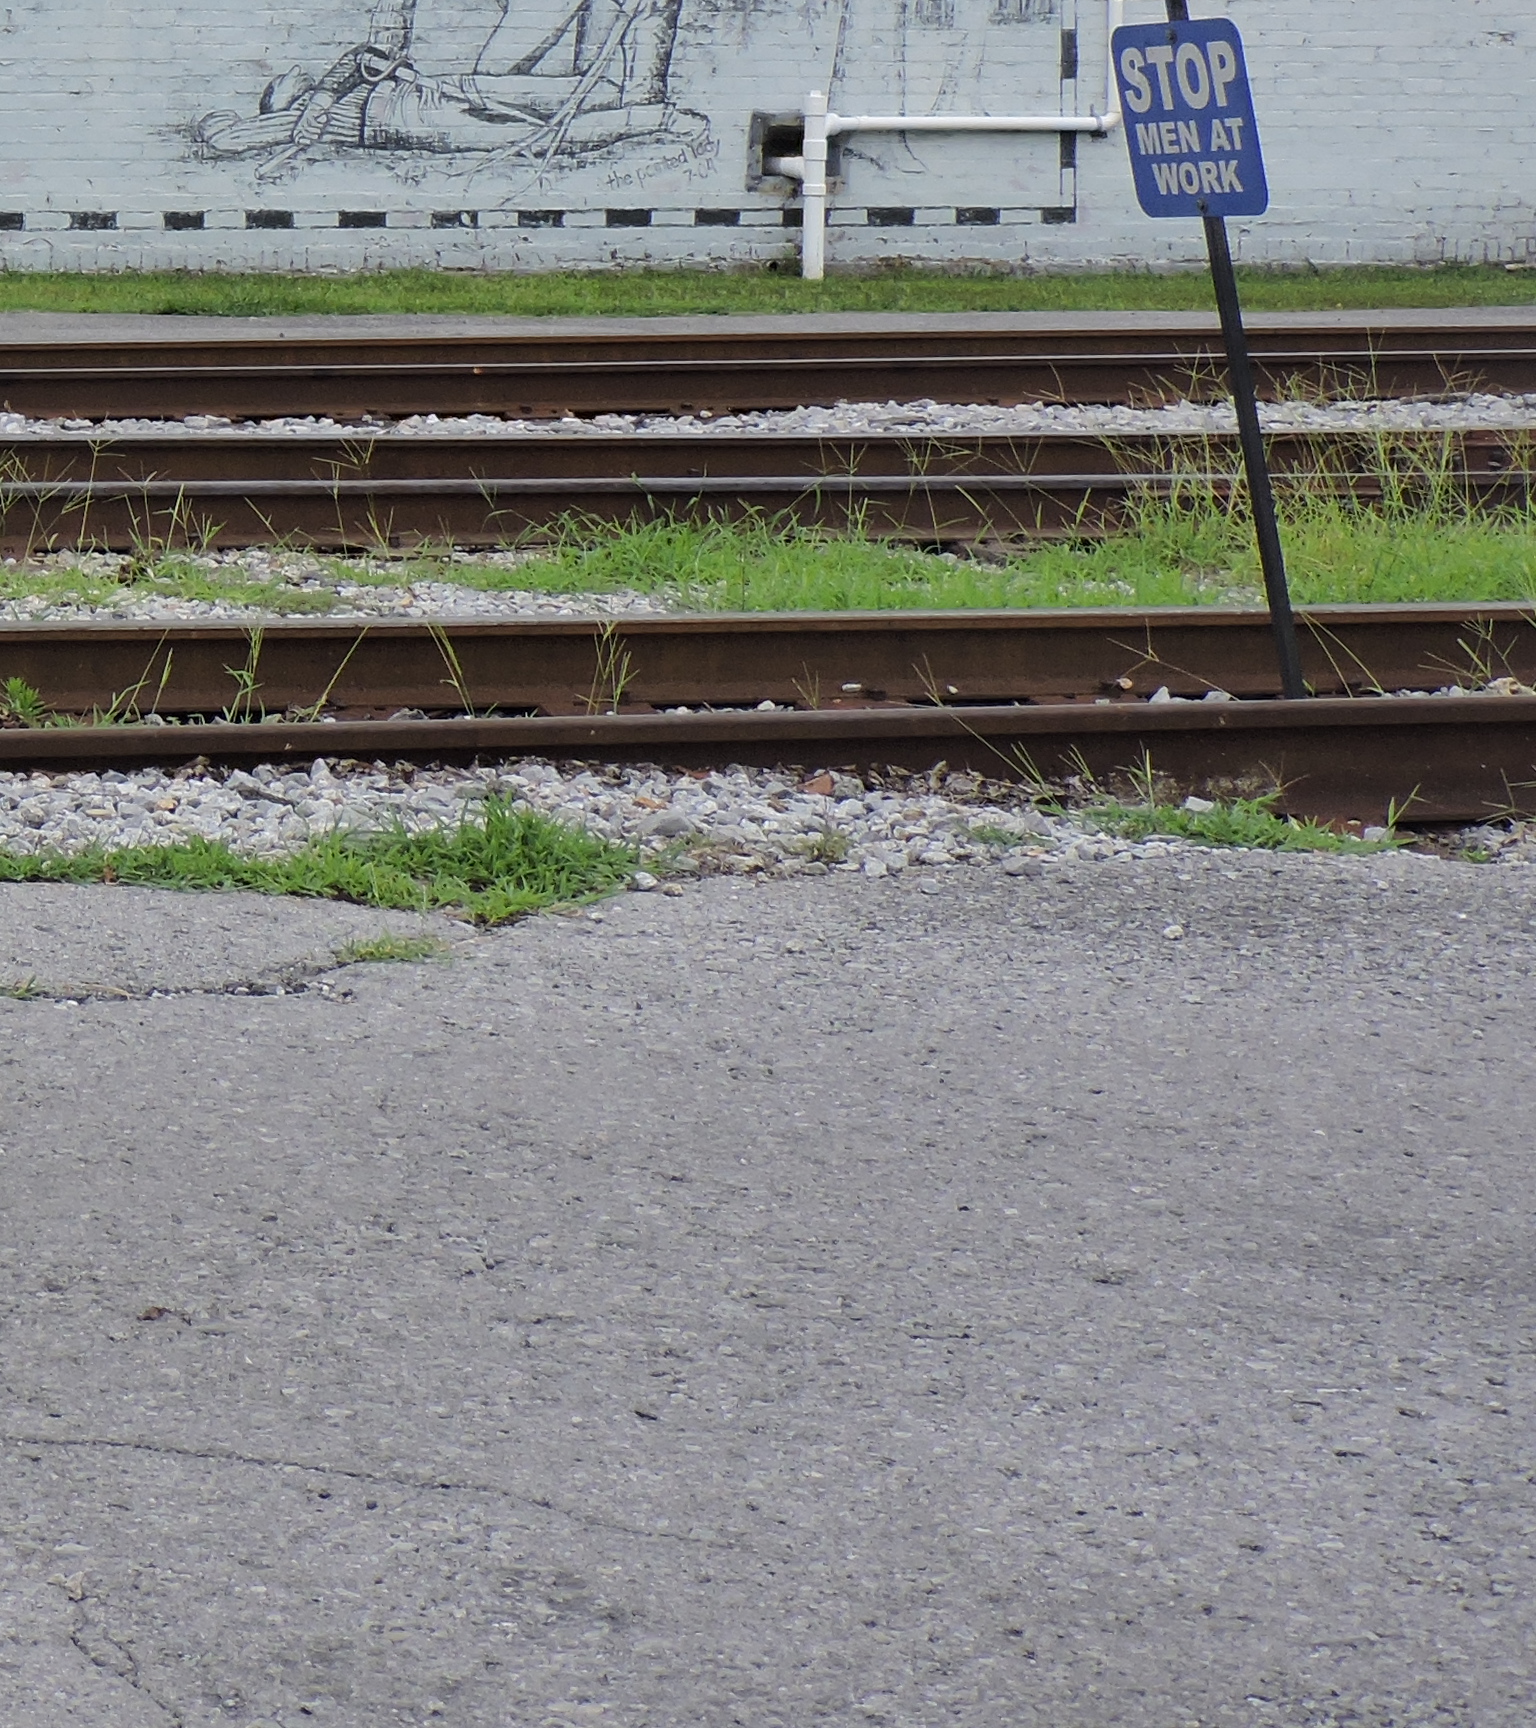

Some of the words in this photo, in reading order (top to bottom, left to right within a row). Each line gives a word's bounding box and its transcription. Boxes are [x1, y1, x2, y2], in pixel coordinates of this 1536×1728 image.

[1121, 40, 1236, 114] STOP
[1135, 119, 1201, 155] MEN
[1211, 117, 1243, 152] AT
[606, 170, 633, 190] the
[1151, 159, 1244, 195] WORK
